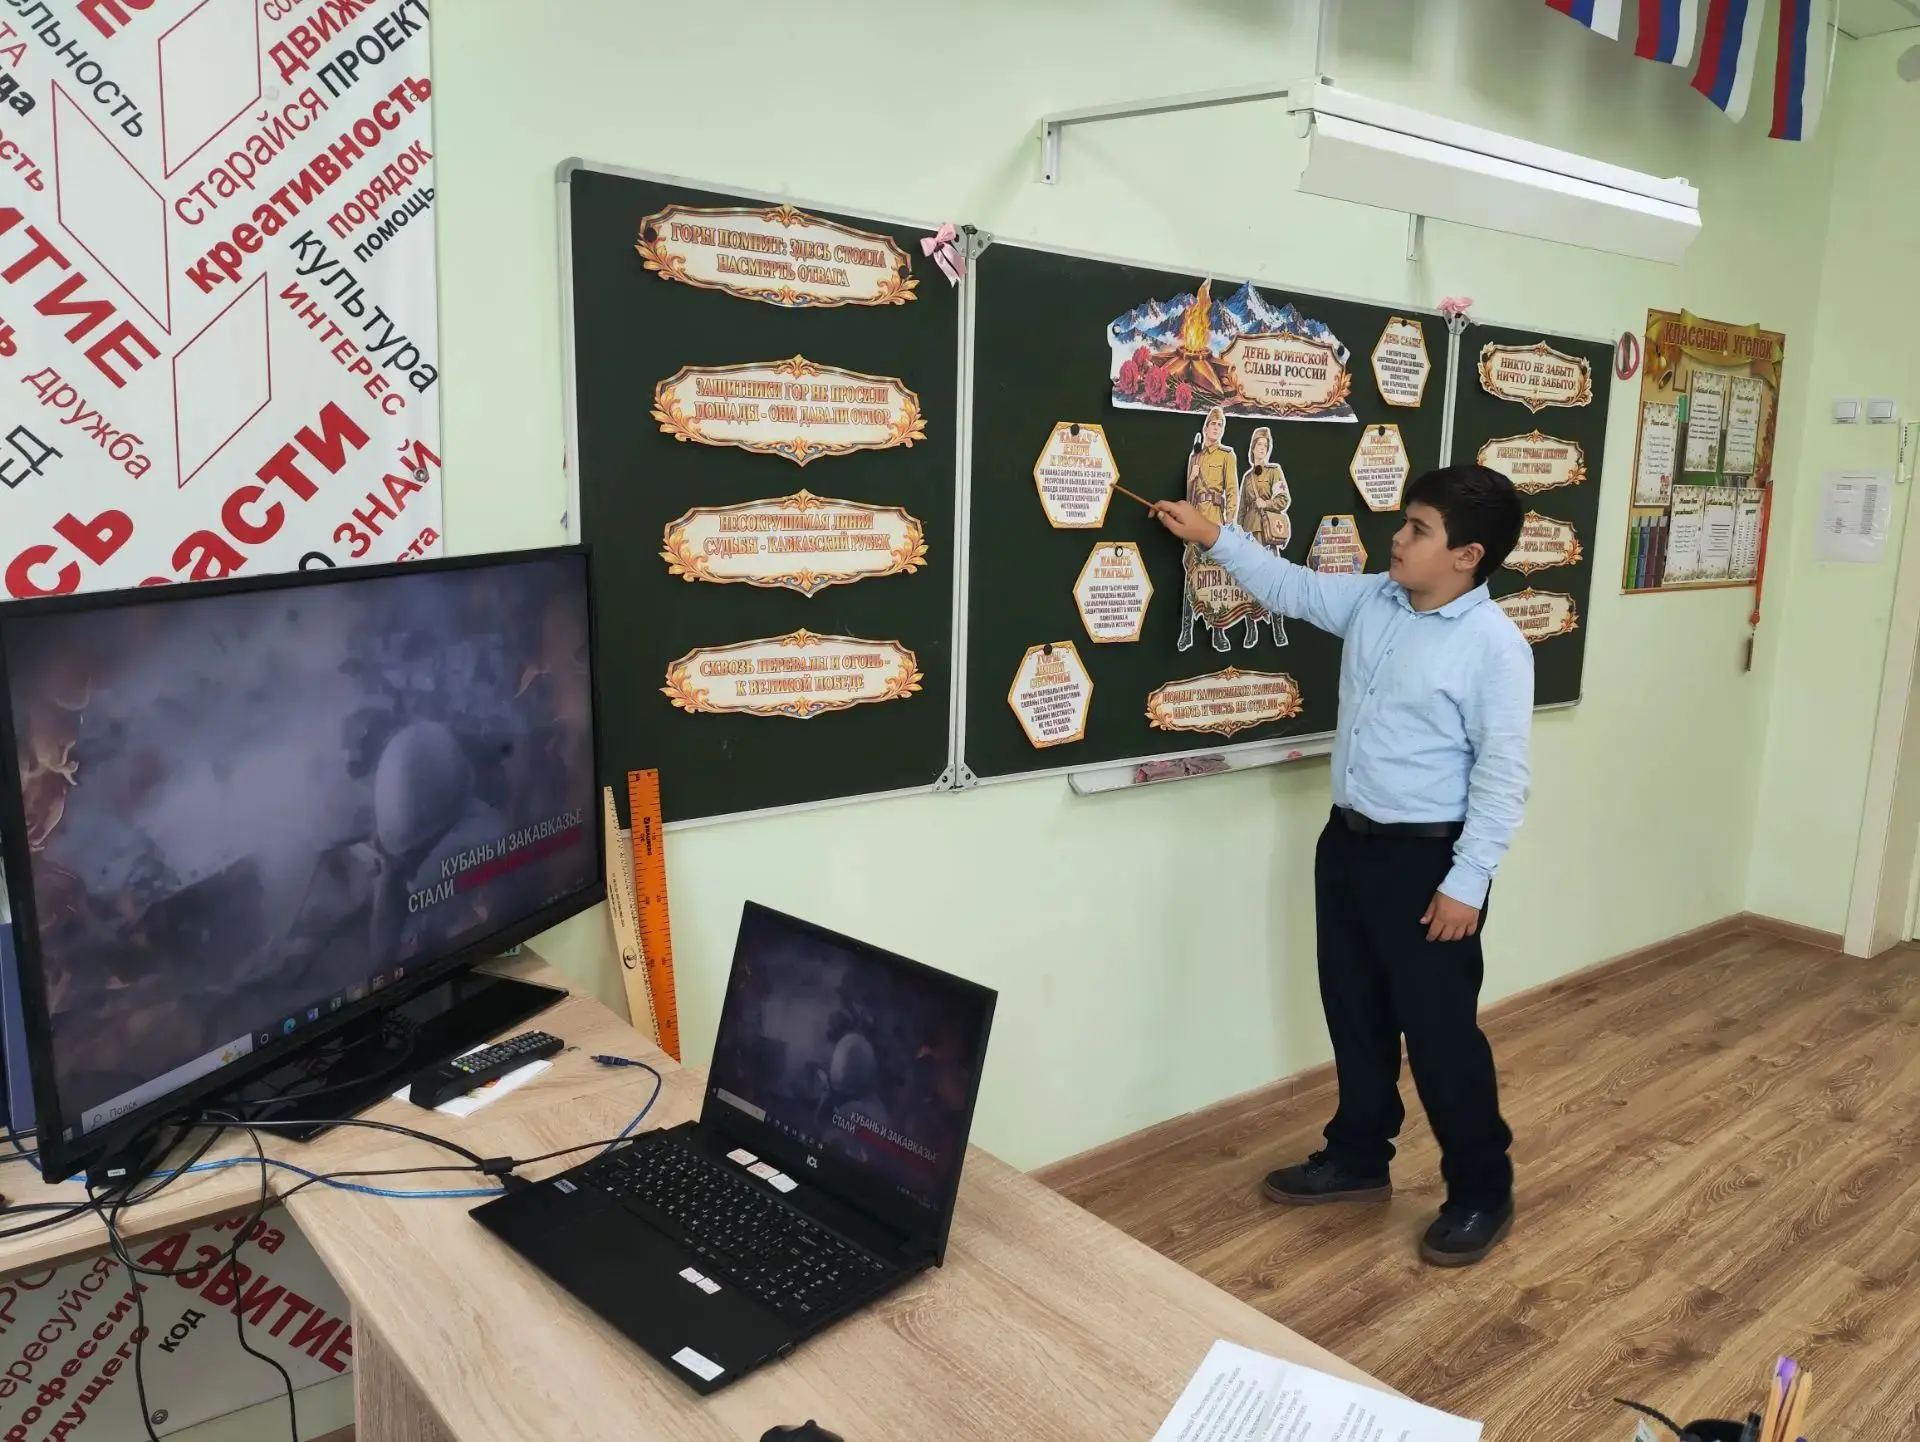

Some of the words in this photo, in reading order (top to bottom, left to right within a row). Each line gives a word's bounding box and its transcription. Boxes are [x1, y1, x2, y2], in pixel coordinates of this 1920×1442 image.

[5, 0, 143, 138] ЛЬНОСТЬ
[174, 87, 329, 225] старайся
[185, 76, 432, 294] креативность
[327, 140, 434, 240] порядок
[353, 187, 434, 263] помощь
[671, 222, 716, 246] ГОРЫ
[717, 230, 788, 257] ПОМНЯТ:
[789, 238, 832, 263] ЗДЕСЬ
[834, 244, 887, 268] СТОЯЛА
[716, 253, 796, 281] НАСМЕРТЬ
[797, 264, 850, 287] ОТВАГА
[289, 229, 438, 394] культура
[279, 281, 405, 416] ИНТЕРЕС
[1242, 345, 1271, 360] ДЕНЬ
[1273, 348, 1329, 366] ВОИНСКОЙ
[1663, 321, 1728, 352] КЛАССНЫЙ
[1733, 333, 1773, 361] УГОЛОК
[1244, 361, 1281, 377] СЛАВЫ
[1285, 365, 1327, 380] РОССИИ
[1496, 370, 1526, 384] НИЧТО
[1529, 375, 1540, 387] НЕ
[1541, 376, 1576, 391] ЗАБЫТО!
[1500, 357, 1531, 372] НИКТО
[1533, 362, 1545, 374] НЕ
[1546, 364, 1574, 378] ЗАБЫТ!
[695, 377, 783, 402] ЗАЩИТНИКИ
[783, 382, 809, 401] ГОР
[811, 383, 829, 402] НЕ
[830, 384, 889, 404] ПРОСИЛИ
[1265, 388, 1270, 397] 9
[1271, 388, 1303, 398] ОКТЯБРЯ
[21, 367, 152, 479] дружба
[694, 401, 759, 427] ПОЩАДЫ
[768, 404, 798, 423] ОНИ
[799, 406, 849, 427] ДАВАЛИ
[849, 408, 892, 426] ОТПОР
[139, 401, 370, 587] асти
[332, 438, 441, 558] ЗНАЙ
[718, 513, 830, 533] НЕСОКРУШИМАЯ
[831, 512, 874, 530] ЛИНИЯ
[703, 536, 759, 559] СУДЬБЫ
[767, 531, 850, 553] КАВКАЗСКИЙ
[850, 533, 891, 552] РУБЕЖ
[1197, 570, 1221, 590] БИТВА
[1210, 588, 1248, 602] 1942-1943
[700, 658, 755, 678] СКВОЗЬ
[757, 656, 829, 675] ПЕРЕВАЛЫ
[830, 655, 840, 671] И
[842, 654, 884, 670] ОГОНЬ
[735, 680, 748, 696] К
[749, 674, 812, 696] ВЕЛИКОЙ
[813, 674, 864, 692] ПОБЕДЕ
[1163, 689, 1194, 705] ПОДВИГ
[1196, 684, 1251, 702] ЗАЩИТНИКОВ
[441, 843, 494, 879] КУБАНЬ
[497, 839, 506, 856] И
[508, 807, 583, 852] ЗАКАВКАЗЬЕ
[407, 878, 454, 913] СТАЛИ
[109, 1101, 138, 1118] Поиск
[832, 1114, 856, 1135] СТАЛИ
[850, 1111, 880, 1134] КУБАНЬ
[887, 1129, 937, 1163] ЗАКАВКАЗЬЕ
[42, 1326, 149, 1442] дущего
